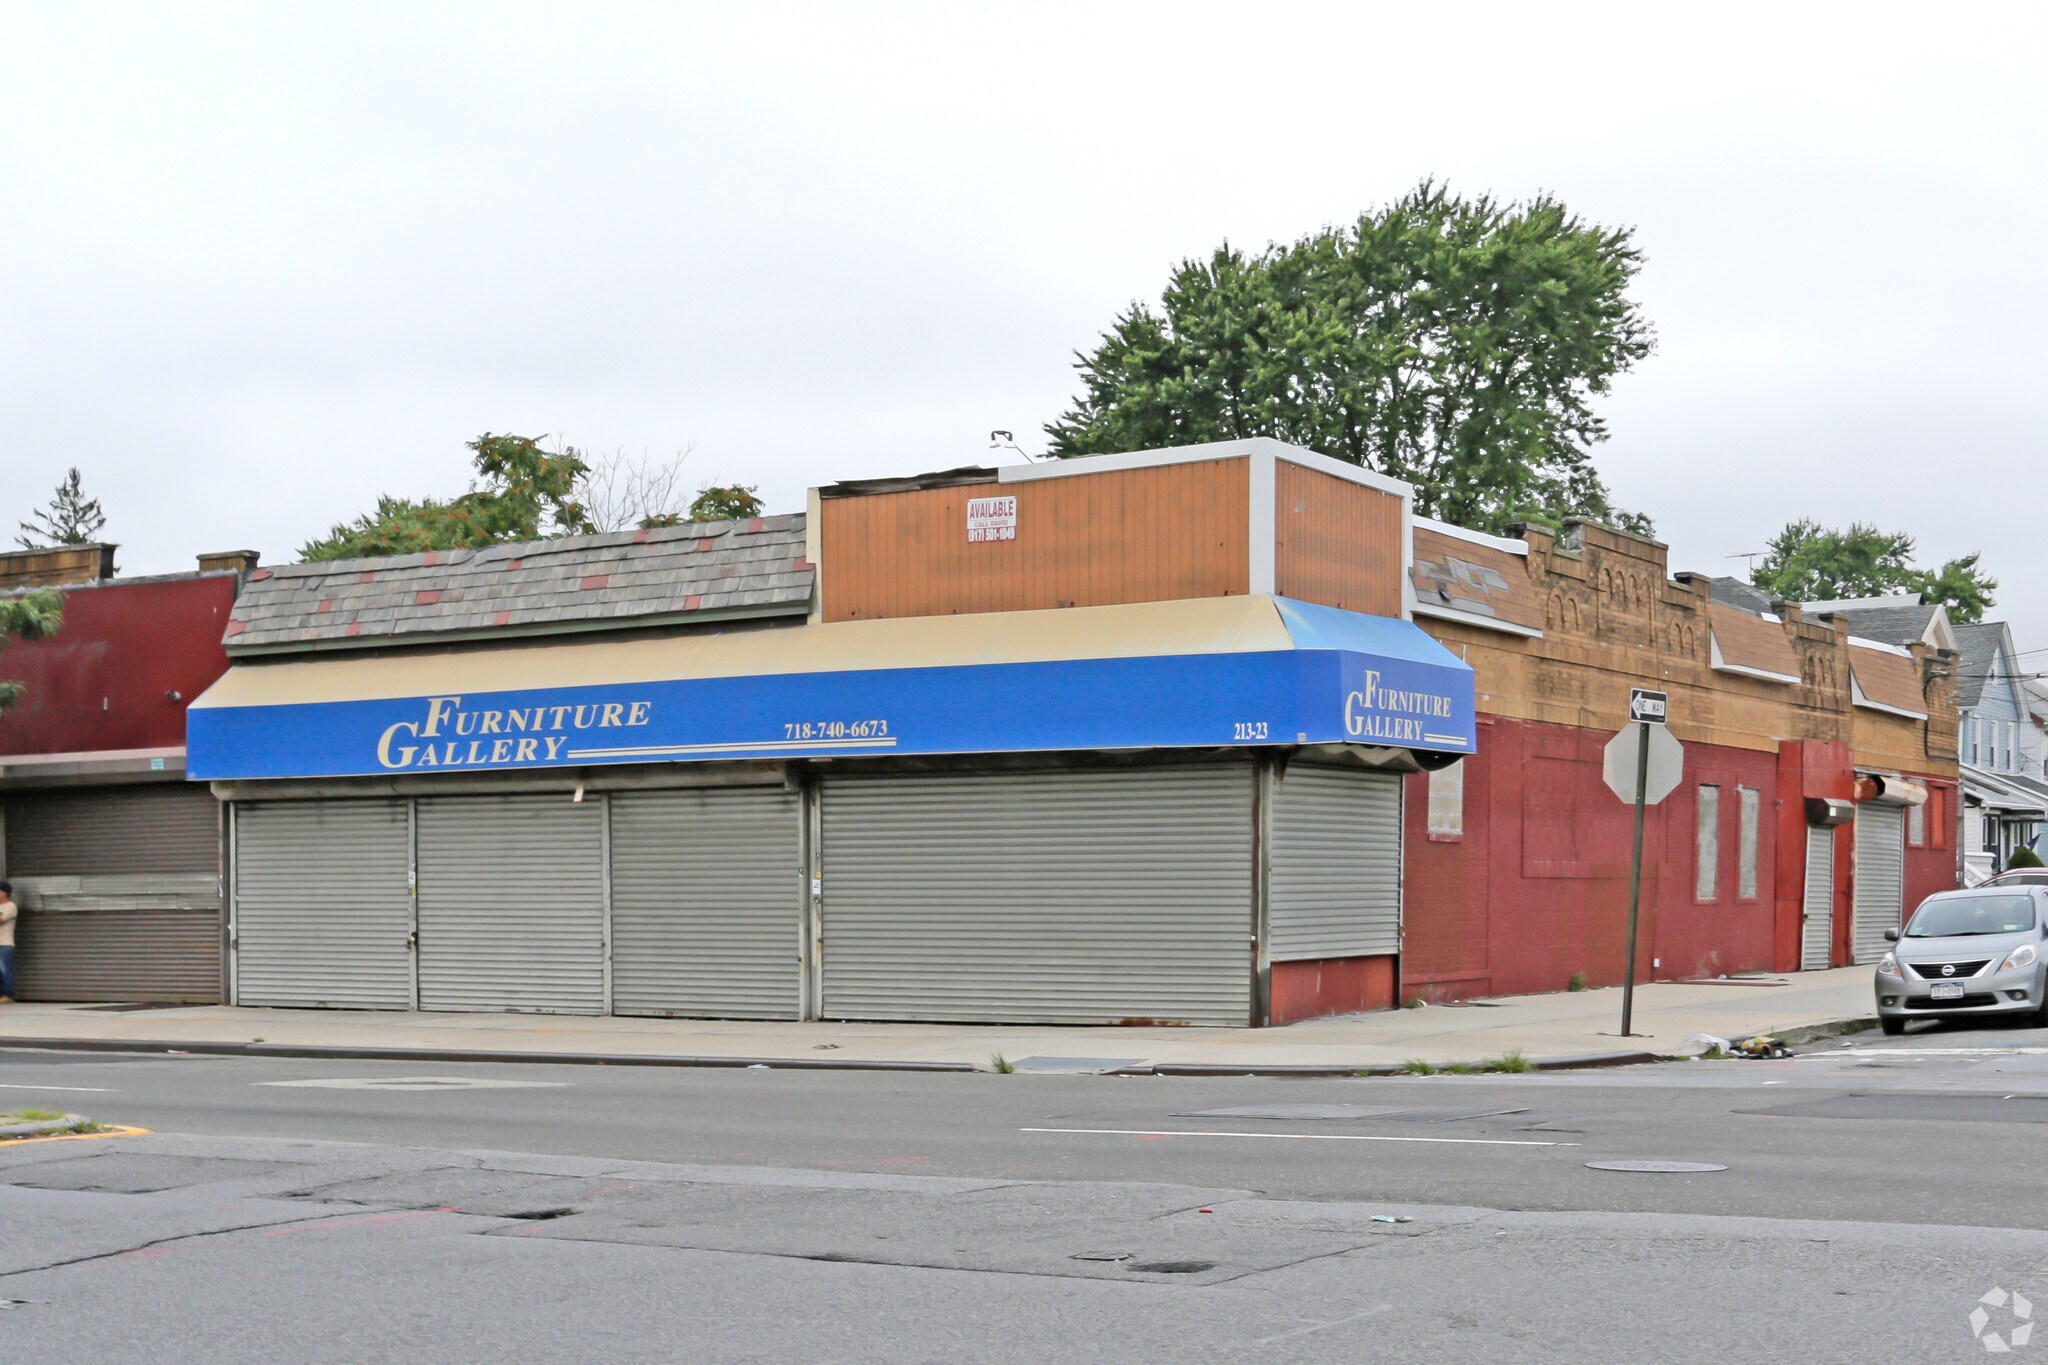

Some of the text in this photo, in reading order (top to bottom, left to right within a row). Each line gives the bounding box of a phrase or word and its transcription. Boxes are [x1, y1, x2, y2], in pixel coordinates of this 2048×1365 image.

[970, 500, 1014, 519] AVAILABLE
[968, 528, 984, 542] (917)
[1363, 669, 1452, 718] FURNITURE
[1344, 690, 1424, 741] GALLERY
[1635, 699, 1665, 714] ONE WAY
[419, 696, 652, 738] FURNITURE
[784, 719, 888, 739] 718-740-6673
[1233, 721, 1268, 740] 213-23
[377, 721, 568, 769] GALLERY
